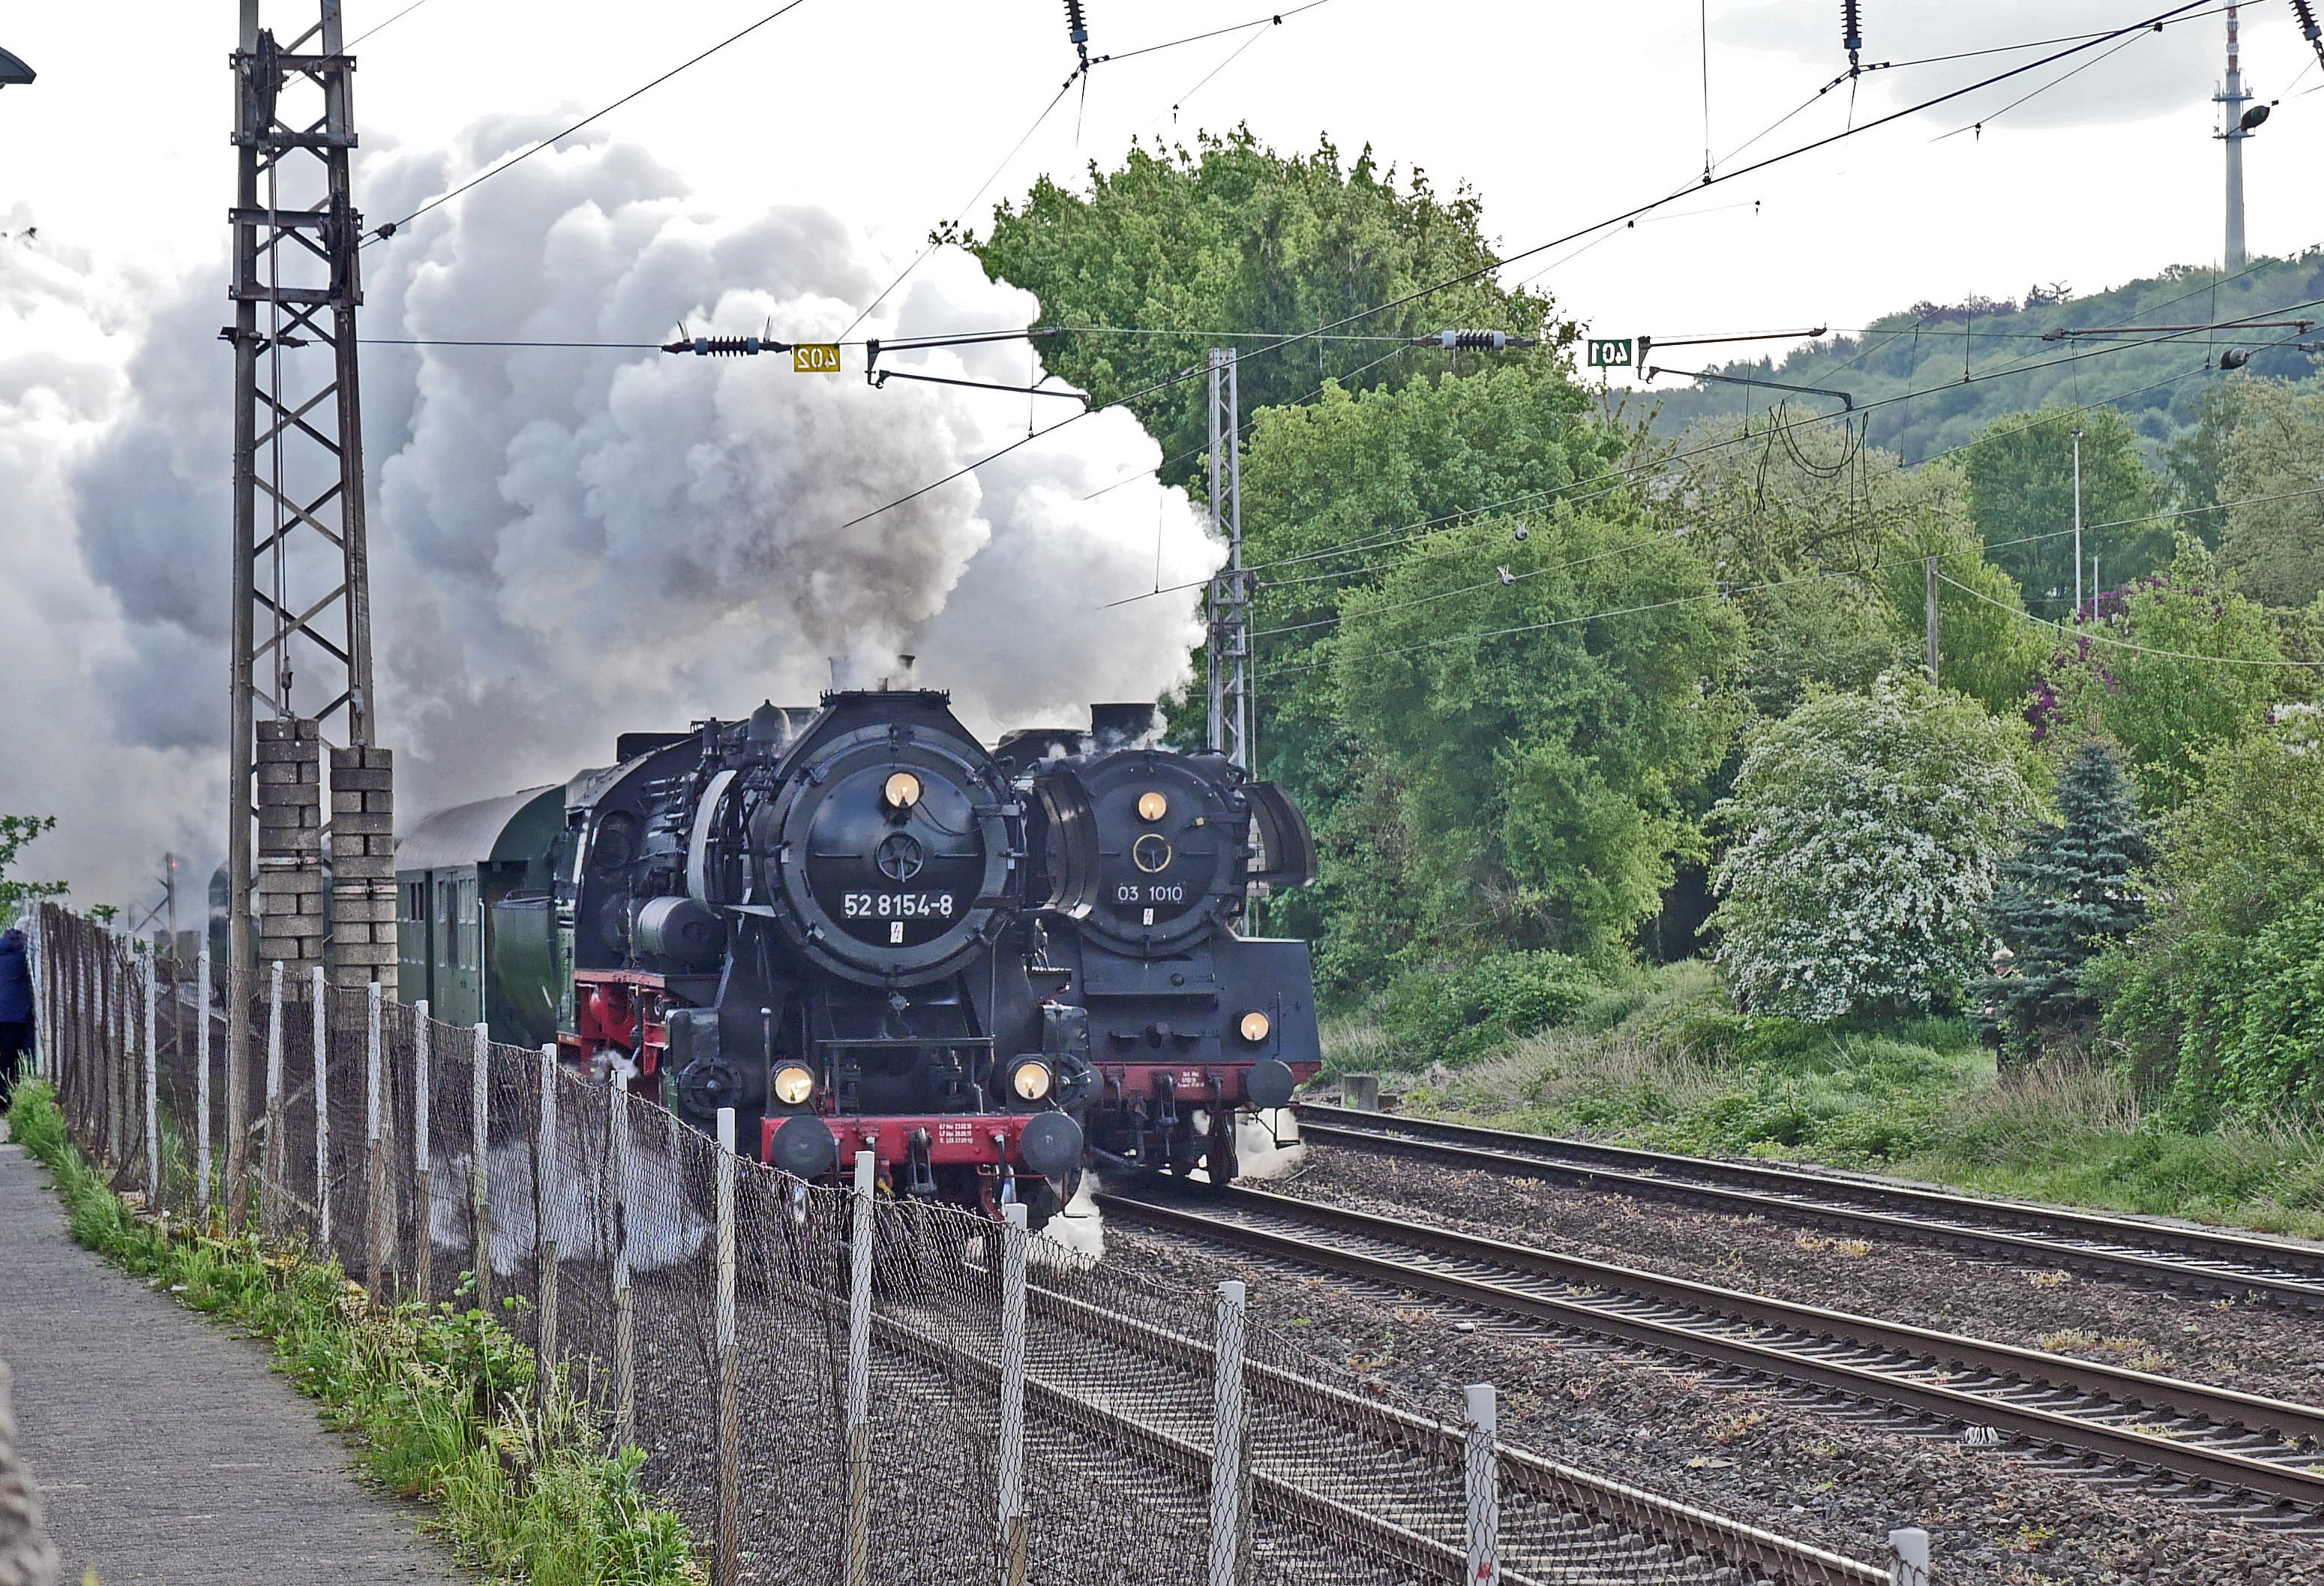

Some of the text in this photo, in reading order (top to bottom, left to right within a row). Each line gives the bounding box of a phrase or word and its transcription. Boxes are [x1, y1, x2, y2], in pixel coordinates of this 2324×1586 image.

[1117, 886, 1183, 901] 03 1010
[844, 894, 953, 916] 52 8154-8
